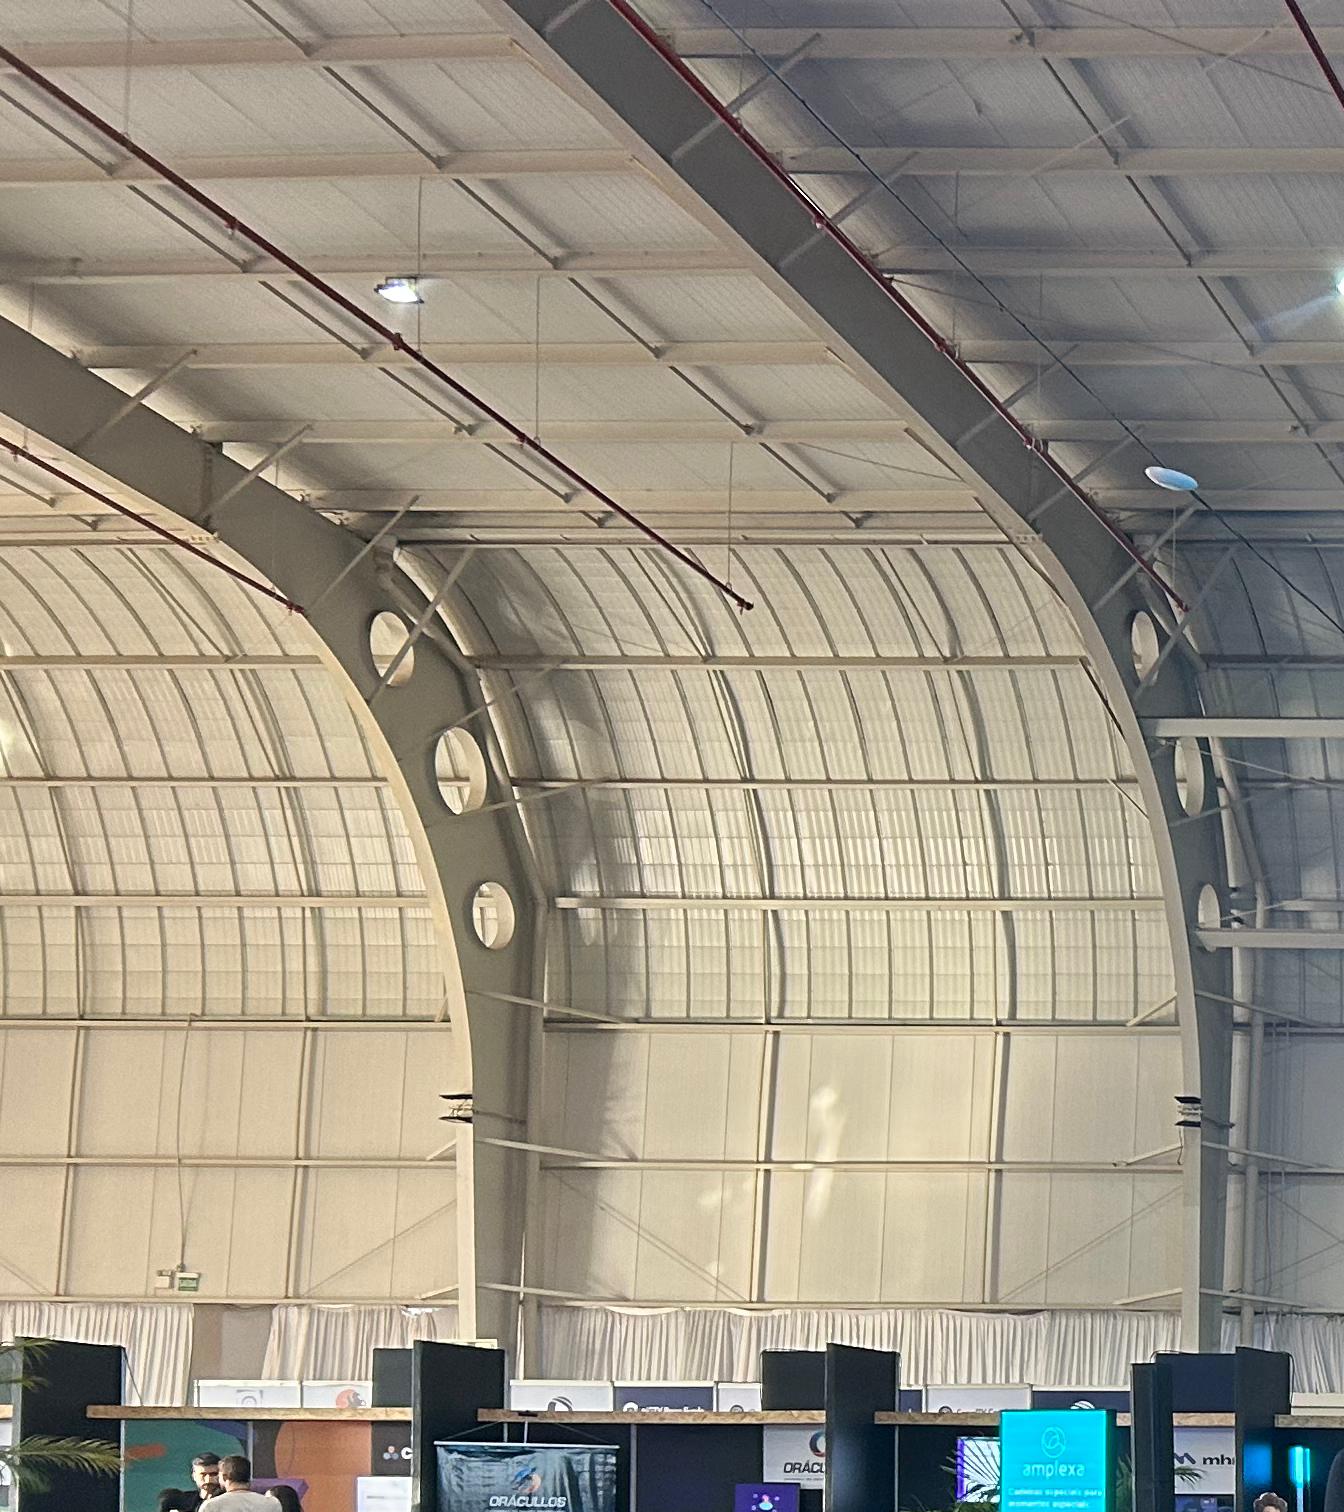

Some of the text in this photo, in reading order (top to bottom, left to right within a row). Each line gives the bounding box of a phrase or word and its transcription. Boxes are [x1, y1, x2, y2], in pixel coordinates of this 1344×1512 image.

[1202, 1453, 1235, 1465] mh
[1022, 1460, 1086, 1479] amplexa
[489, 1494, 567, 1508] ORÁCULLOS
